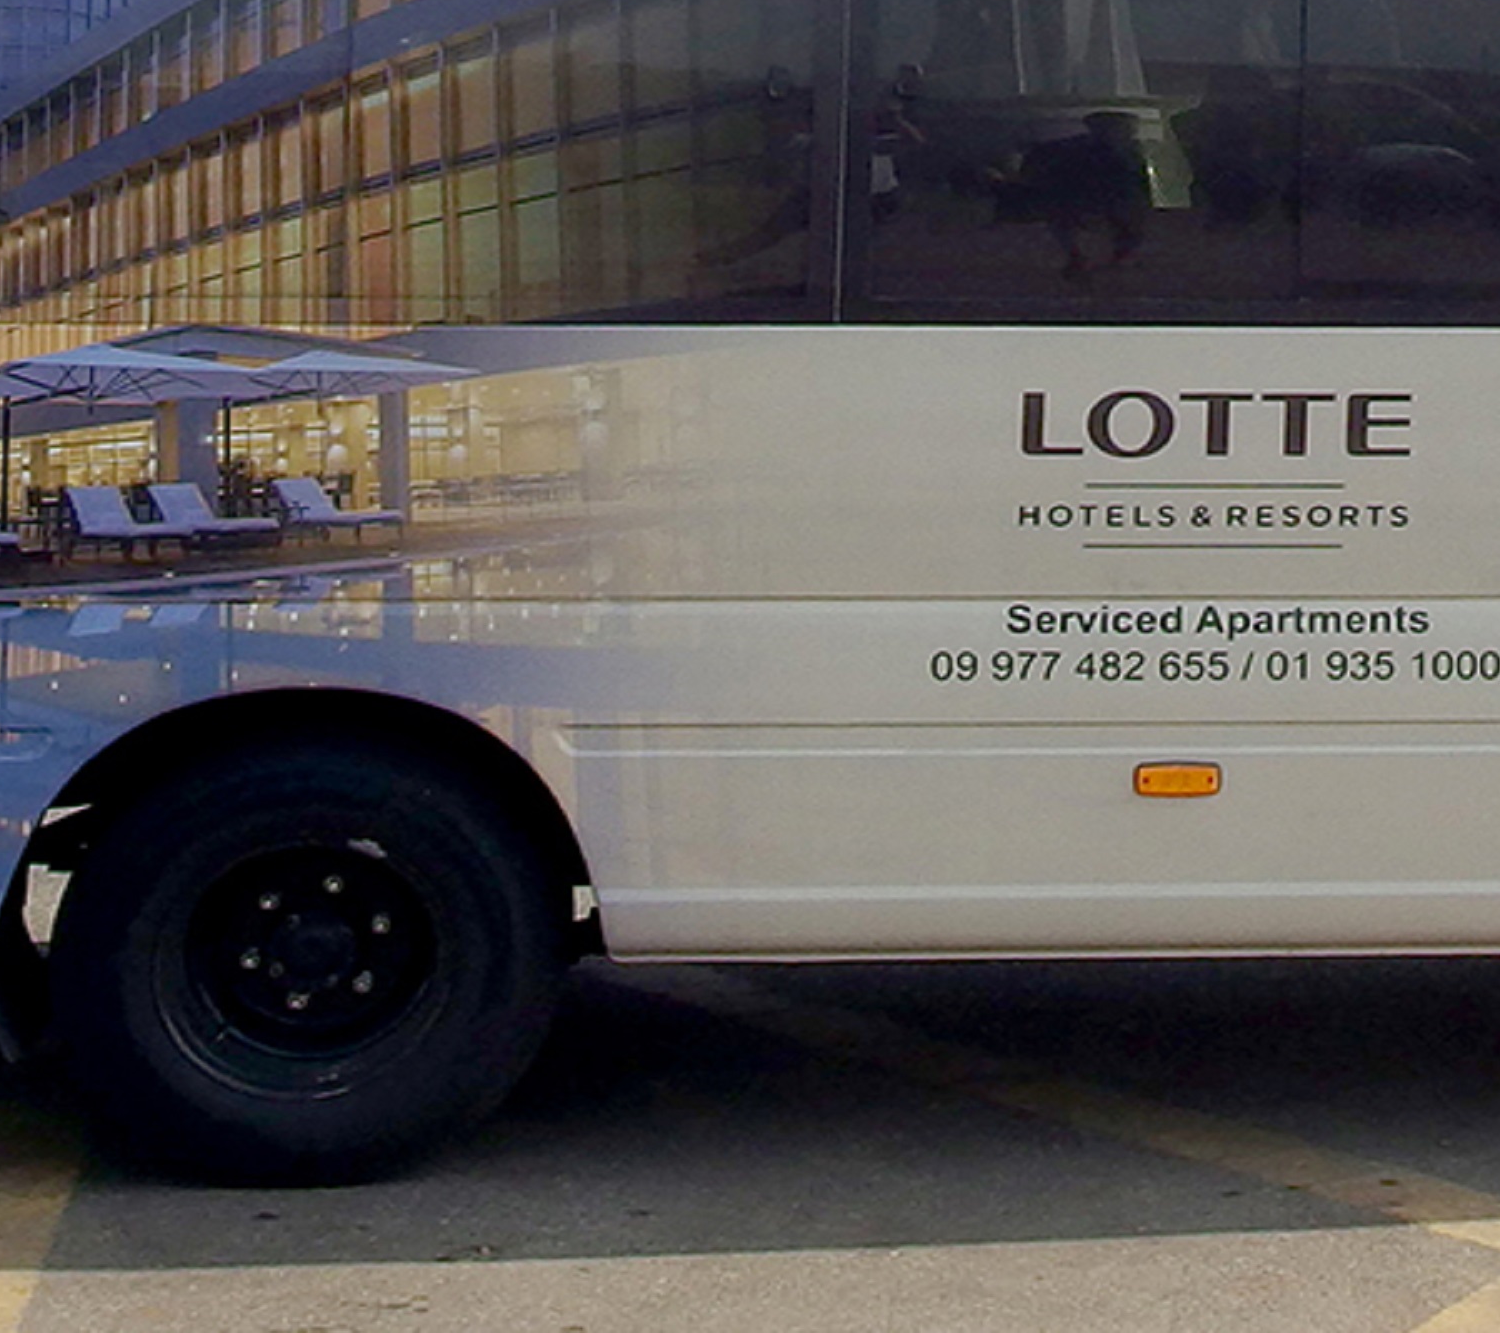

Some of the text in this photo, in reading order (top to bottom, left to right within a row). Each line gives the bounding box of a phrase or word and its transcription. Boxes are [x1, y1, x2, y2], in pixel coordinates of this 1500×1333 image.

[1022, 391, 1412, 458] LOTTE
[1018, 504, 1410, 528] HOTELS & RESORTS
[1007, 604, 1431, 640] Serviced Apartments
[929, 650, 978, 682] 09
[991, 650, 1060, 682] 977
[1073, 650, 1146, 682] 482
[1158, 650, 1230, 682] 655
[1240, 650, 1254, 682] /
[1266, 650, 1310, 682] 01
[1326, 650, 1395, 682] 935
